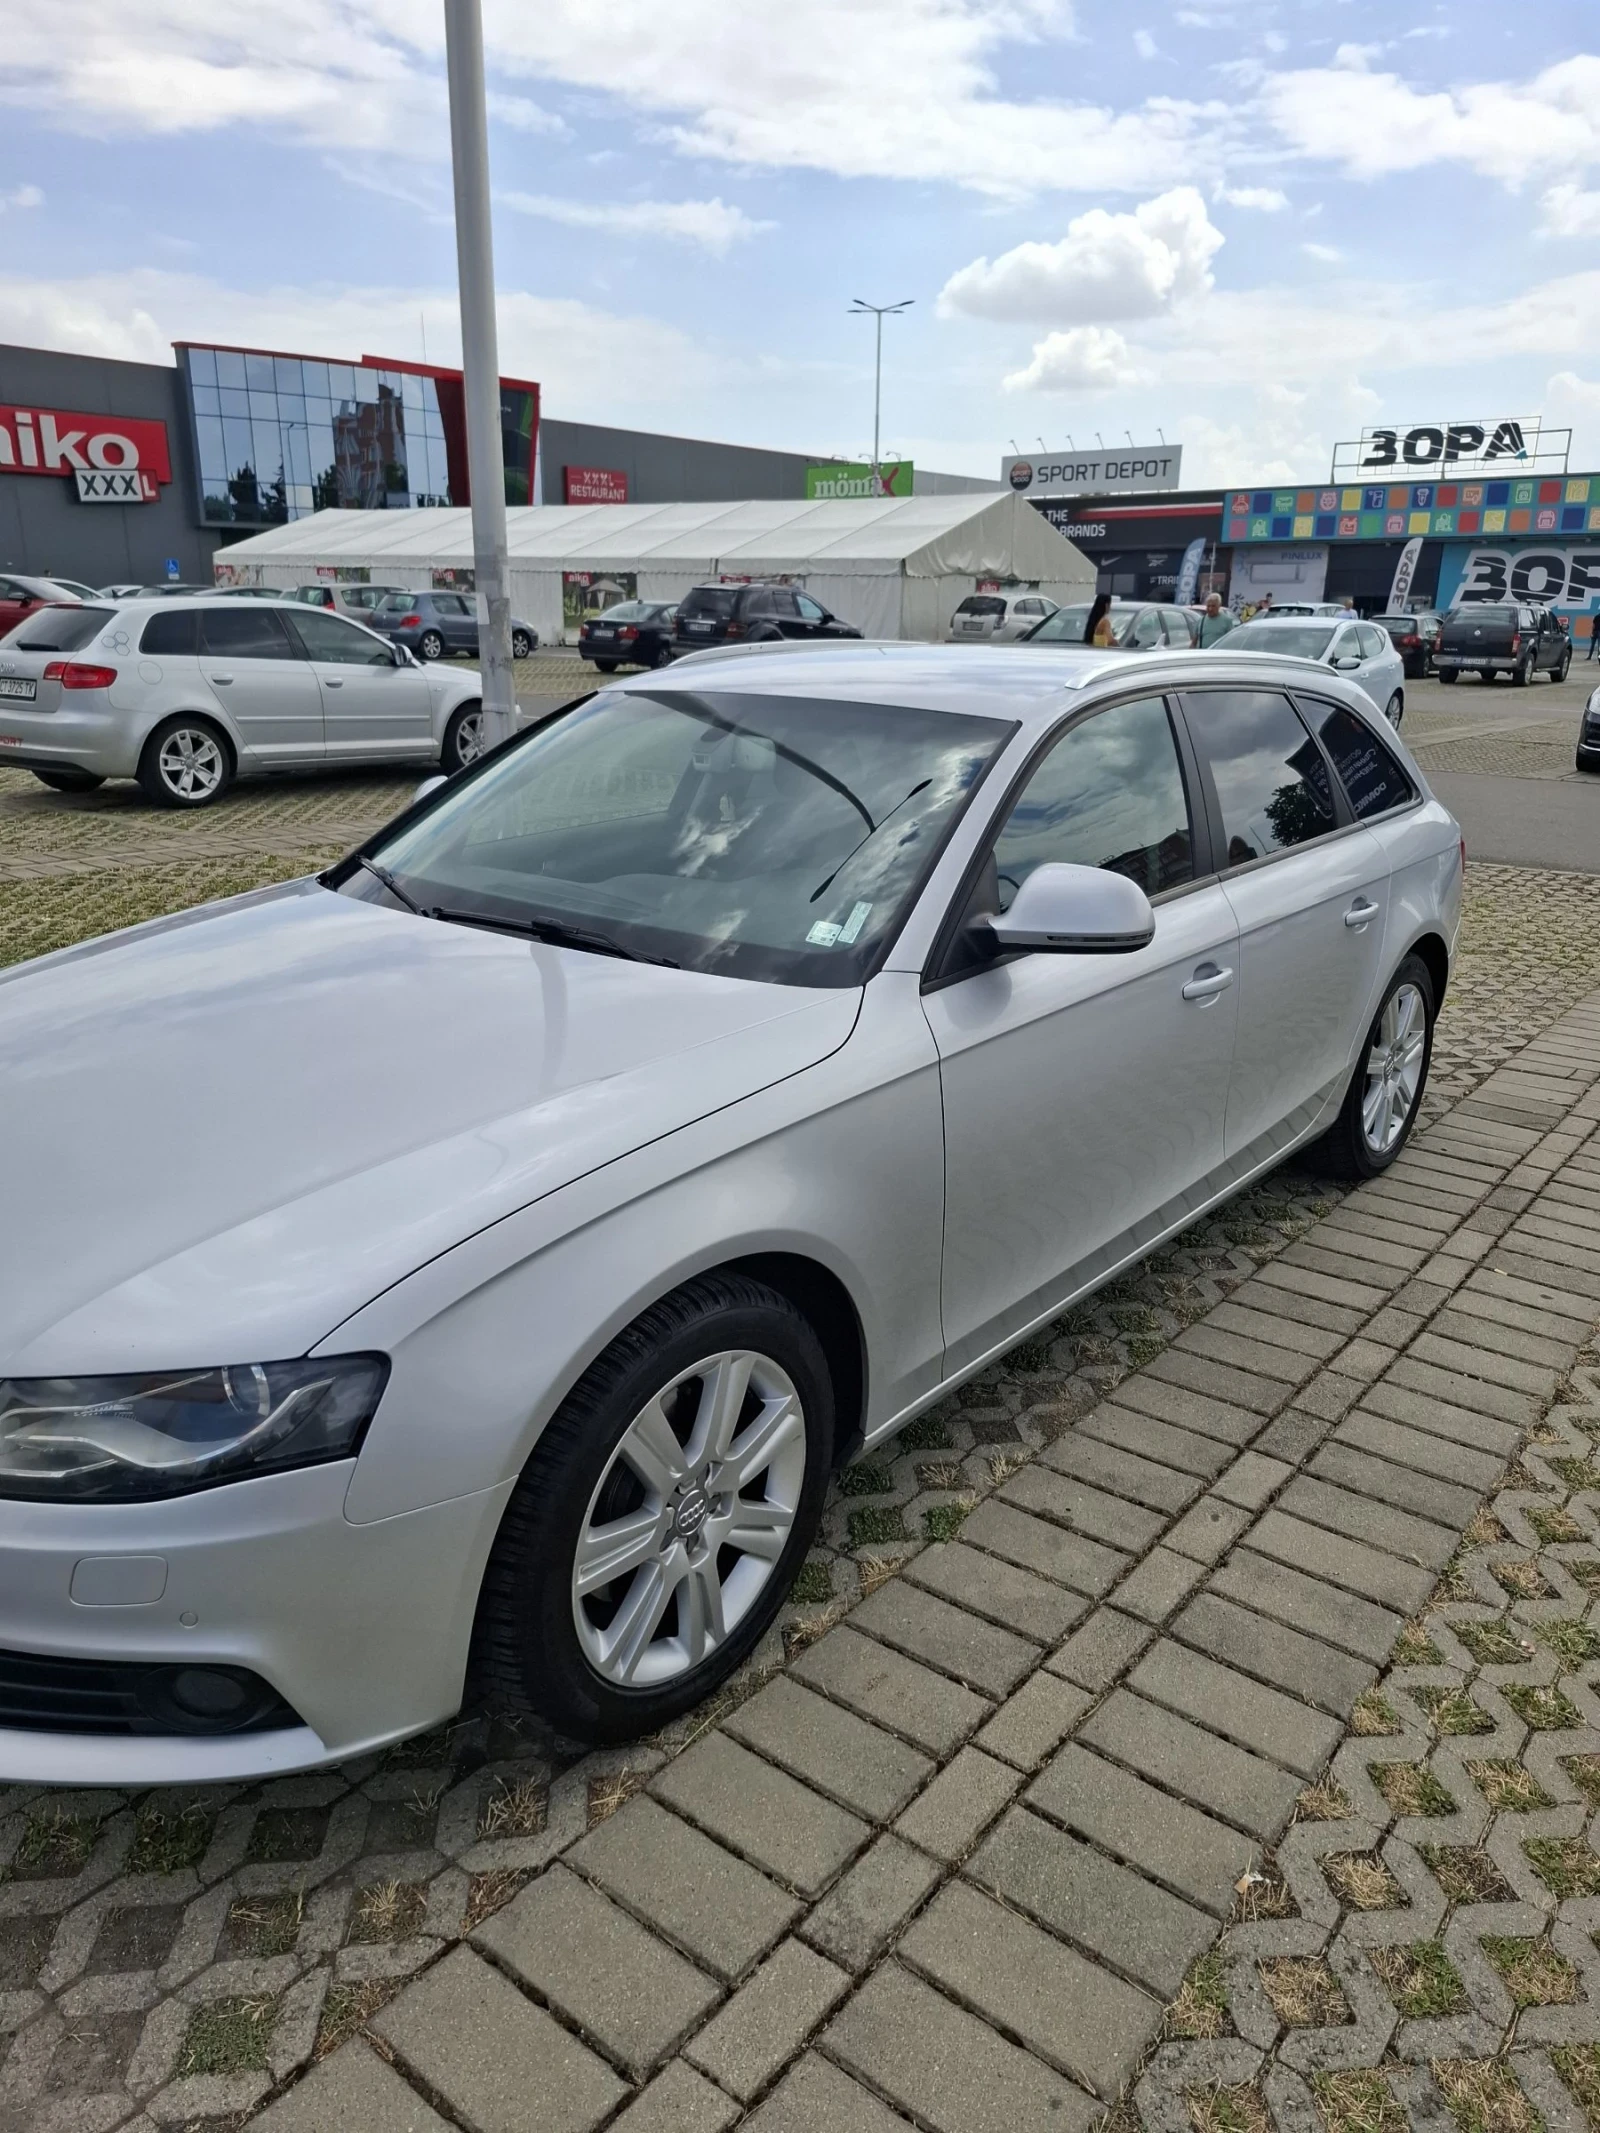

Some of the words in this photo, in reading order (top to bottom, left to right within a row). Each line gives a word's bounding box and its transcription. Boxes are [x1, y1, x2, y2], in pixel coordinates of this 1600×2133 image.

[0, 411, 139, 470] iko
[1362, 422, 1528, 467] ЗОРА
[1037, 463, 1101, 483] SPORT
[1105, 459, 1172, 480] DEPOT
[81, 474, 156, 497] XXXL
[570, 484, 625, 500] RESTAURANT
[1046, 509, 1069, 522] THE
[1060, 523, 1107, 538] BRANDS
